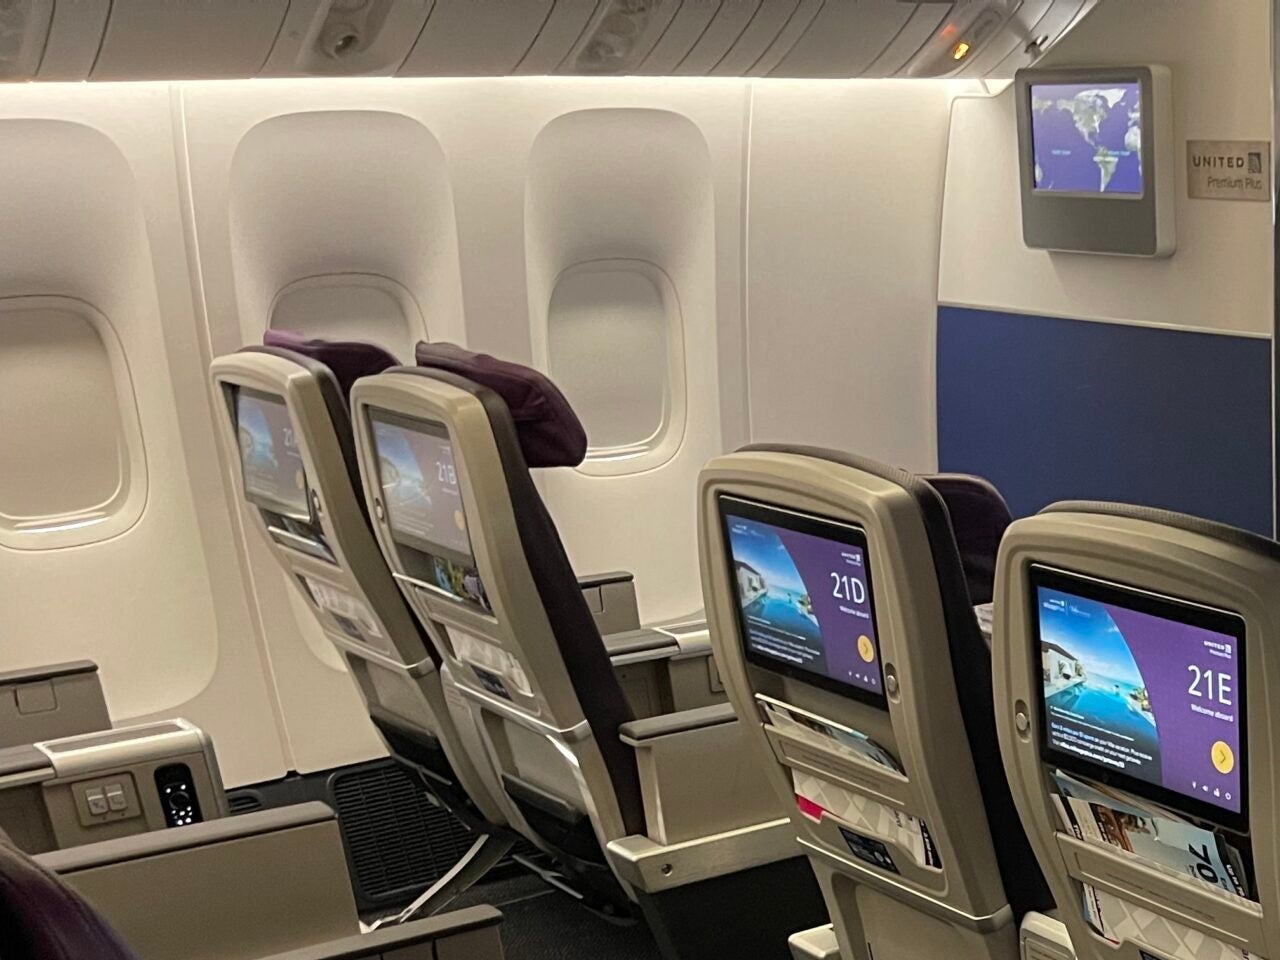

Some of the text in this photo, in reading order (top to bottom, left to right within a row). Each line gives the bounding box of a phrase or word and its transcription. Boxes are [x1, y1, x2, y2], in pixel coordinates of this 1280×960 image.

[1192, 155, 1245, 168] UNITED
[1207, 176, 1263, 190] Premium Plus
[830, 572, 866, 604] 21D
[1187, 664, 1232, 705] 21E
[1190, 703, 1234, 722] Welcome aboard
[1188, 843, 1219, 884] 70
